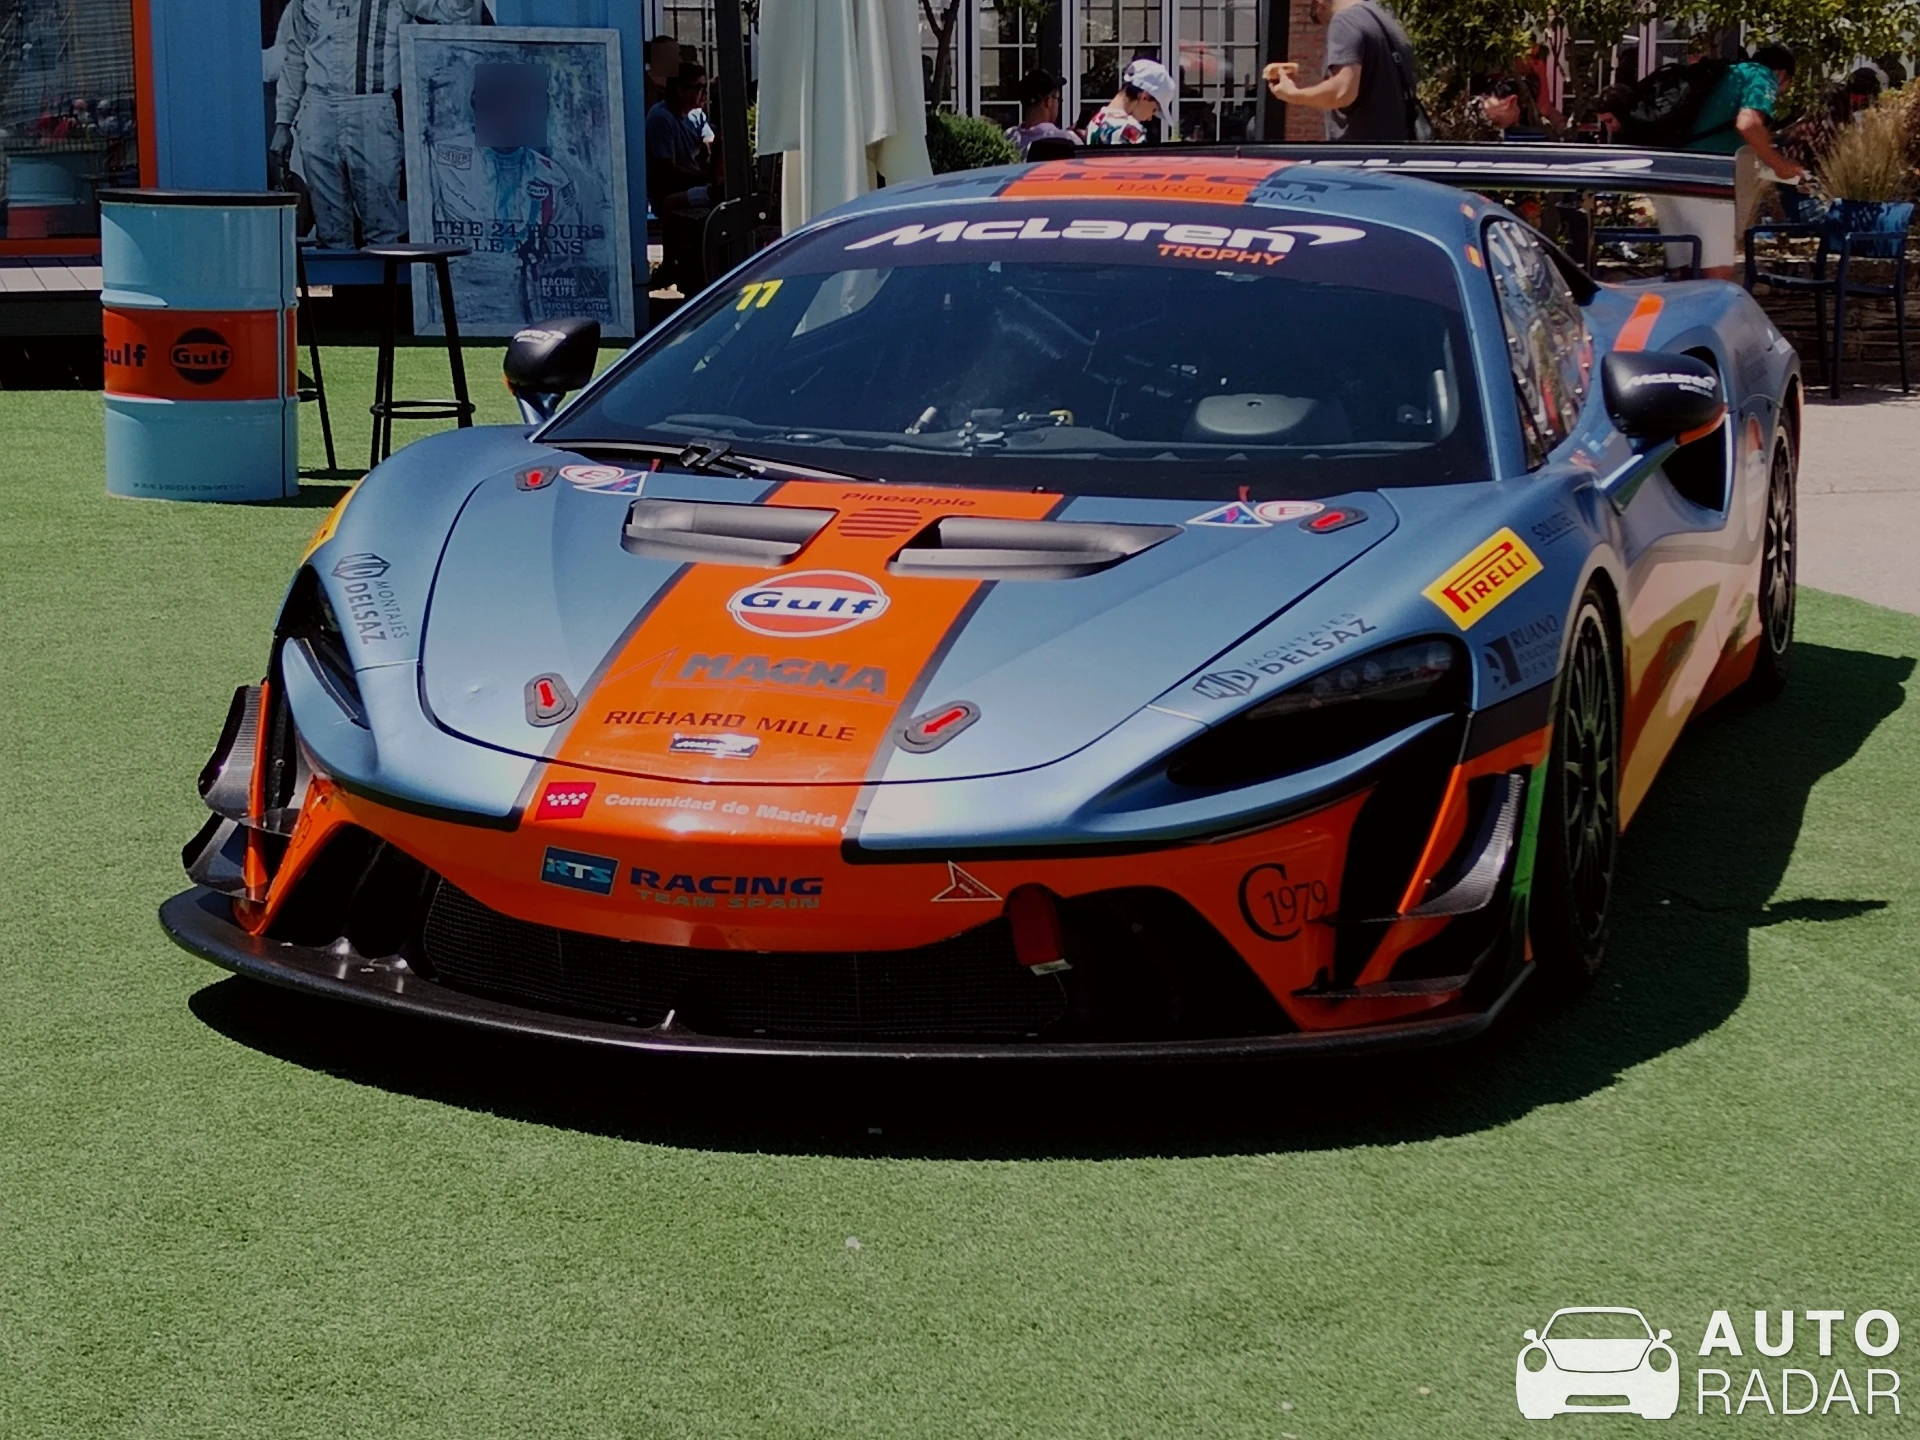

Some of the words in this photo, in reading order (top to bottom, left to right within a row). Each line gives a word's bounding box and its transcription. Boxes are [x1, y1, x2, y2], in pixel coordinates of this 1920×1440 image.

[1116, 183, 1316, 203] BARCELONA
[433, 220, 484, 237] THE
[491, 223, 518, 238] 24
[526, 222, 606, 240] HOURS
[845, 217, 1300, 254] McLaren
[472, 238, 504, 253] LE
[1157, 243, 1287, 265] TROPHY
[541, 277, 578, 287] RACING
[542, 286, 553, 297] IS
[556, 286, 578, 297] LIFE
[736, 279, 784, 311] 11
[172, 347, 232, 365] Gulf
[841, 492, 976, 507] Pineapple
[1441, 541, 1528, 613] PIRELLI
[344, 582, 388, 645] DELSAZ
[375, 580, 410, 639] MONTAJES
[741, 591, 879, 614] Gulf
[1244, 612, 1356, 668] MONTAJES
[1259, 618, 1377, 675] DELSAZ
[678, 653, 888, 696] MAGNA
[604, 711, 747, 728] RICHARD
[755, 716, 857, 742] MILLE
[604, 793, 716, 813] Comunidad
[721, 801, 749, 816] de
[755, 804, 837, 828] Madrid
[546, 857, 612, 884] RTS
[630, 867, 824, 895] RACING
[636, 889, 715, 908] TEAM
[728, 896, 820, 909] SPAIN
[1262, 880, 1329, 926] 1979
